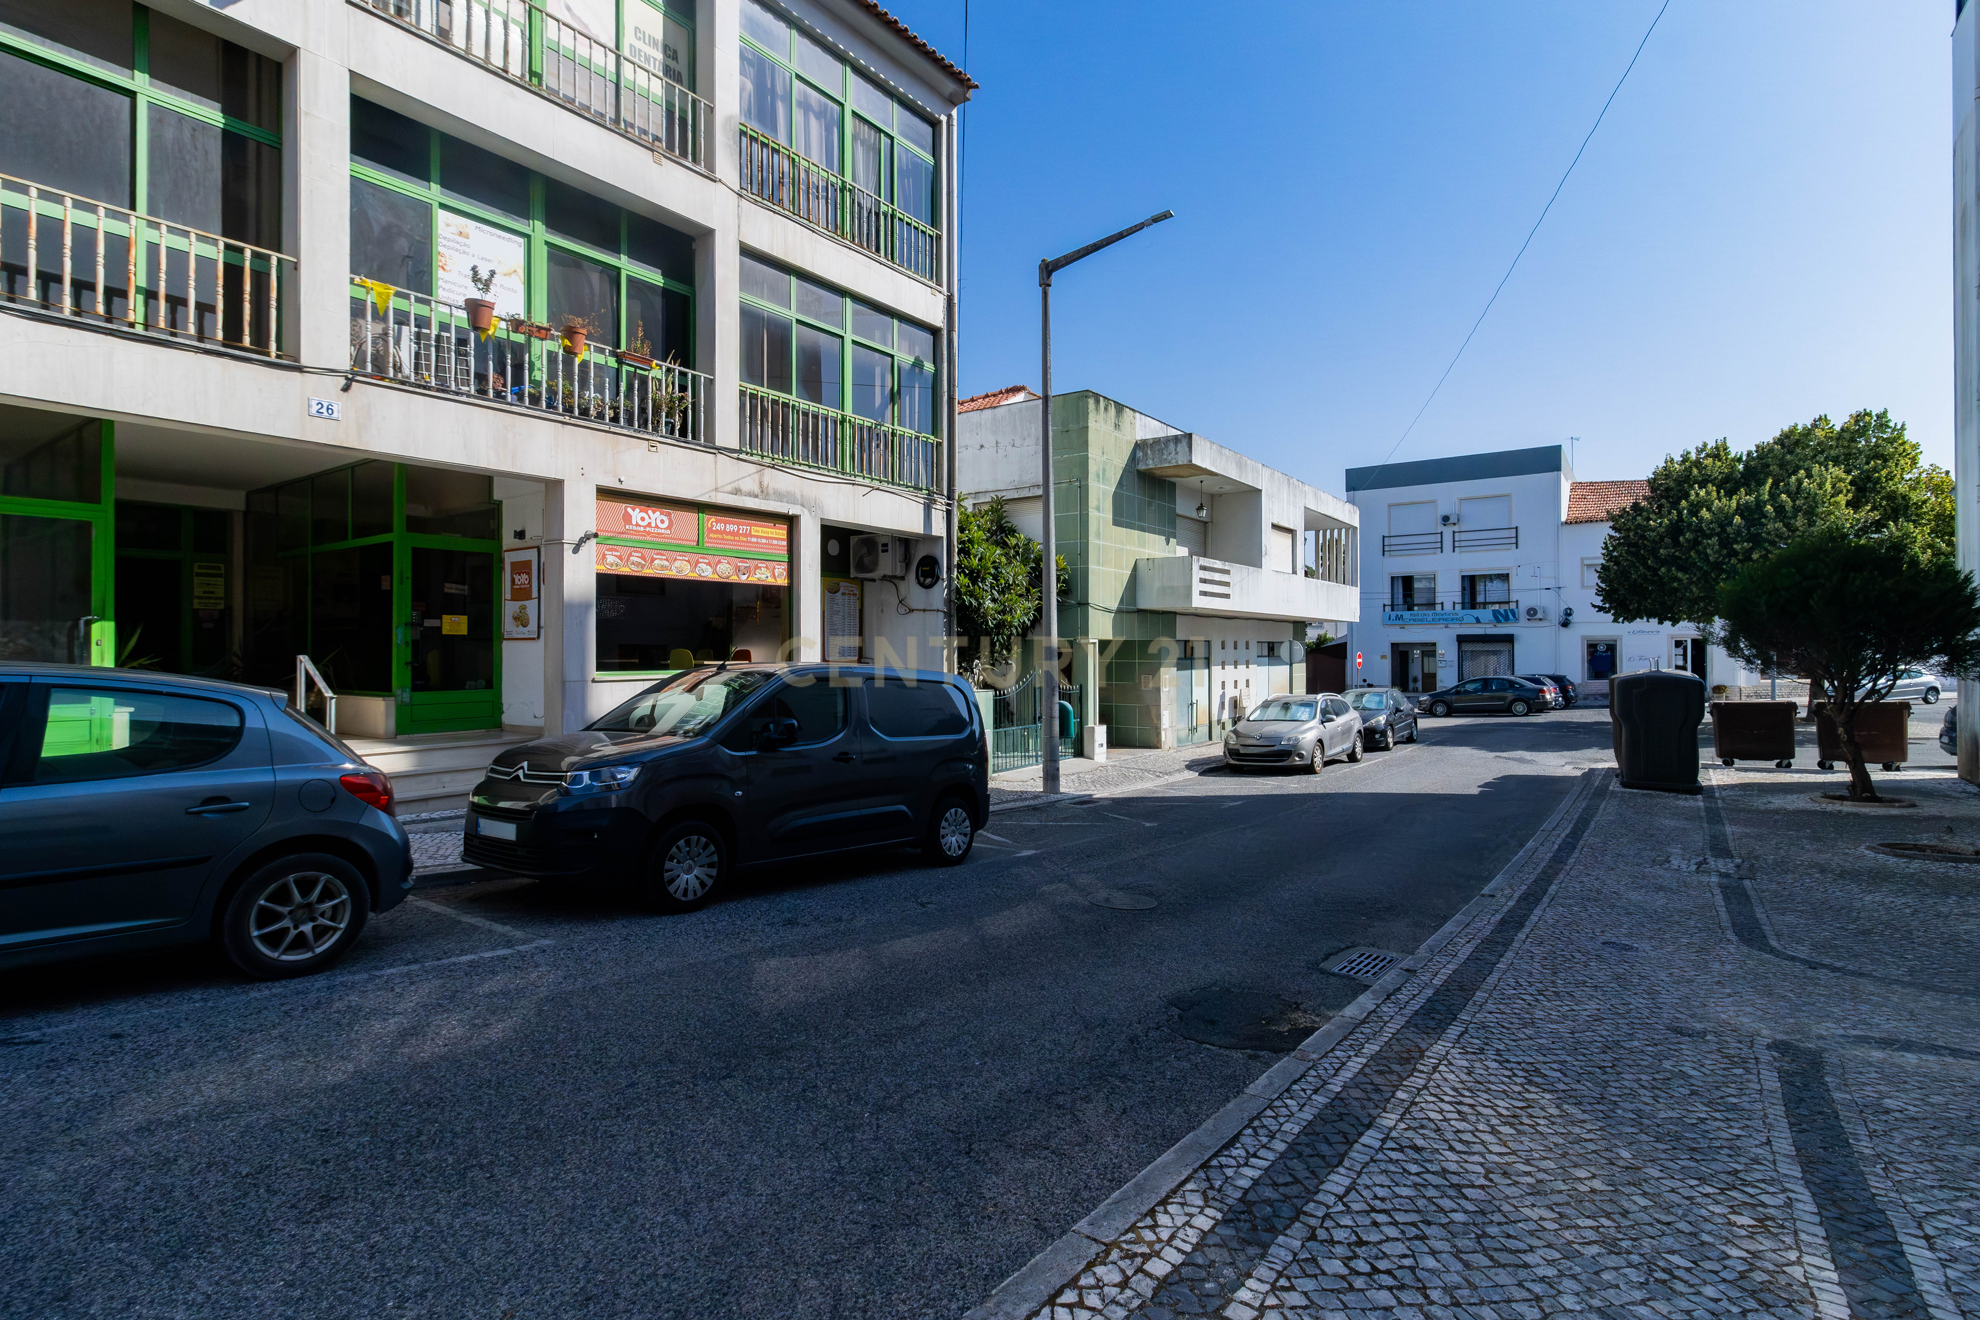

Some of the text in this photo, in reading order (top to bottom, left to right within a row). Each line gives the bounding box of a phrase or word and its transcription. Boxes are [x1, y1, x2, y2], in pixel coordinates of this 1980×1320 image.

[438, 233, 471, 248] Depilação
[474, 225, 522, 248] Microneedling
[438, 241, 470, 256] Depilação
[477, 254, 494, 264] Laser
[438, 277, 469, 291] Manicure
[499, 283, 518, 294] Rosto
[438, 285, 467, 298] Pedicure
[316, 401, 334, 416] 26
[712, 522, 750, 534] 249 899 277
